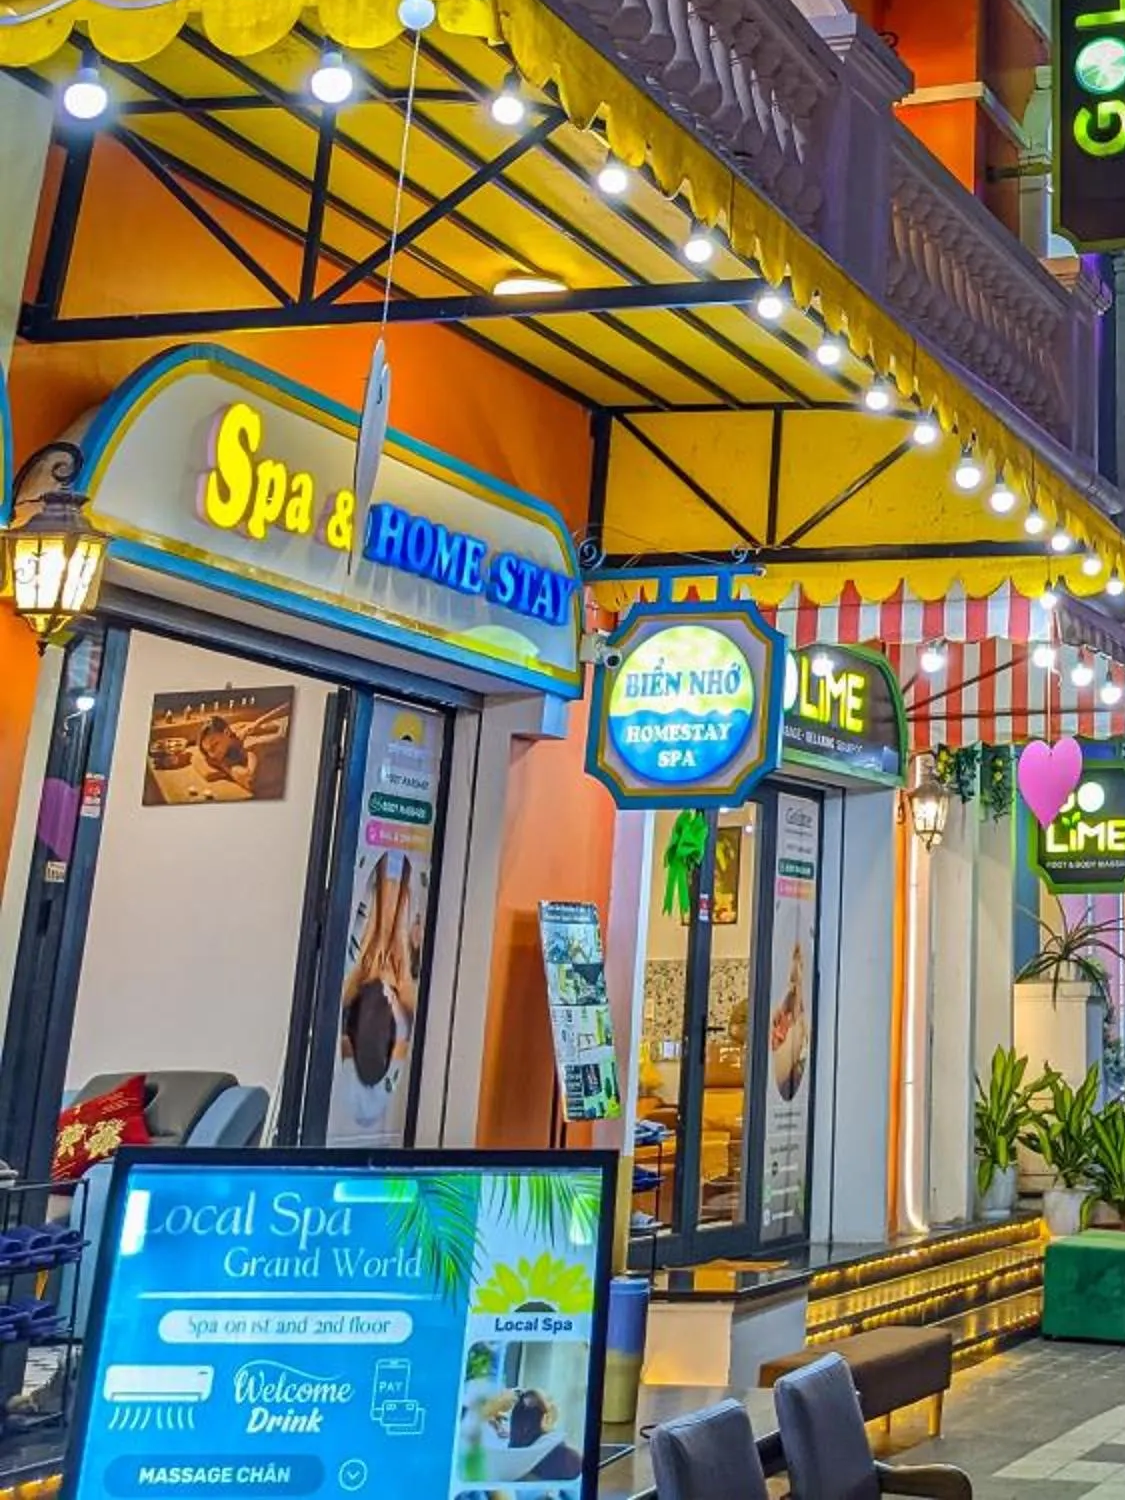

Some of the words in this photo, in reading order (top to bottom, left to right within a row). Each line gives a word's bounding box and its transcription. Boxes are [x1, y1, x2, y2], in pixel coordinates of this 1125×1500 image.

[206, 403, 313, 539] Spa
[327, 489, 355, 550] &
[368, 502, 487, 595] HOME
[490, 553, 578, 626] STAY
[625, 658, 682, 698] BIỂN
[690, 662, 741, 696] NHỚ
[626, 723, 732, 743] HOMESTAY
[657, 749, 697, 768] SPA
[143, 1192, 255, 1238] Local
[270, 1190, 352, 1250] Spa
[223, 1247, 320, 1279] Grand
[333, 1247, 424, 1279] World
[187, 1315, 220, 1340] Spa
[224, 1320, 247, 1335] on
[277, 1314, 310, 1335] and
[313, 1314, 346, 1335] 2nd
[348, 1314, 392, 1335] floor
[495, 1316, 537, 1334] Local
[539, 1317, 574, 1336] Spa
[233, 1360, 356, 1405] Welcome
[379, 1381, 403, 1394] PAY
[246, 1408, 325, 1435] Drink
[138, 1466, 233, 1485] MASSAGE
[236, 1464, 292, 1485] CHÂN
